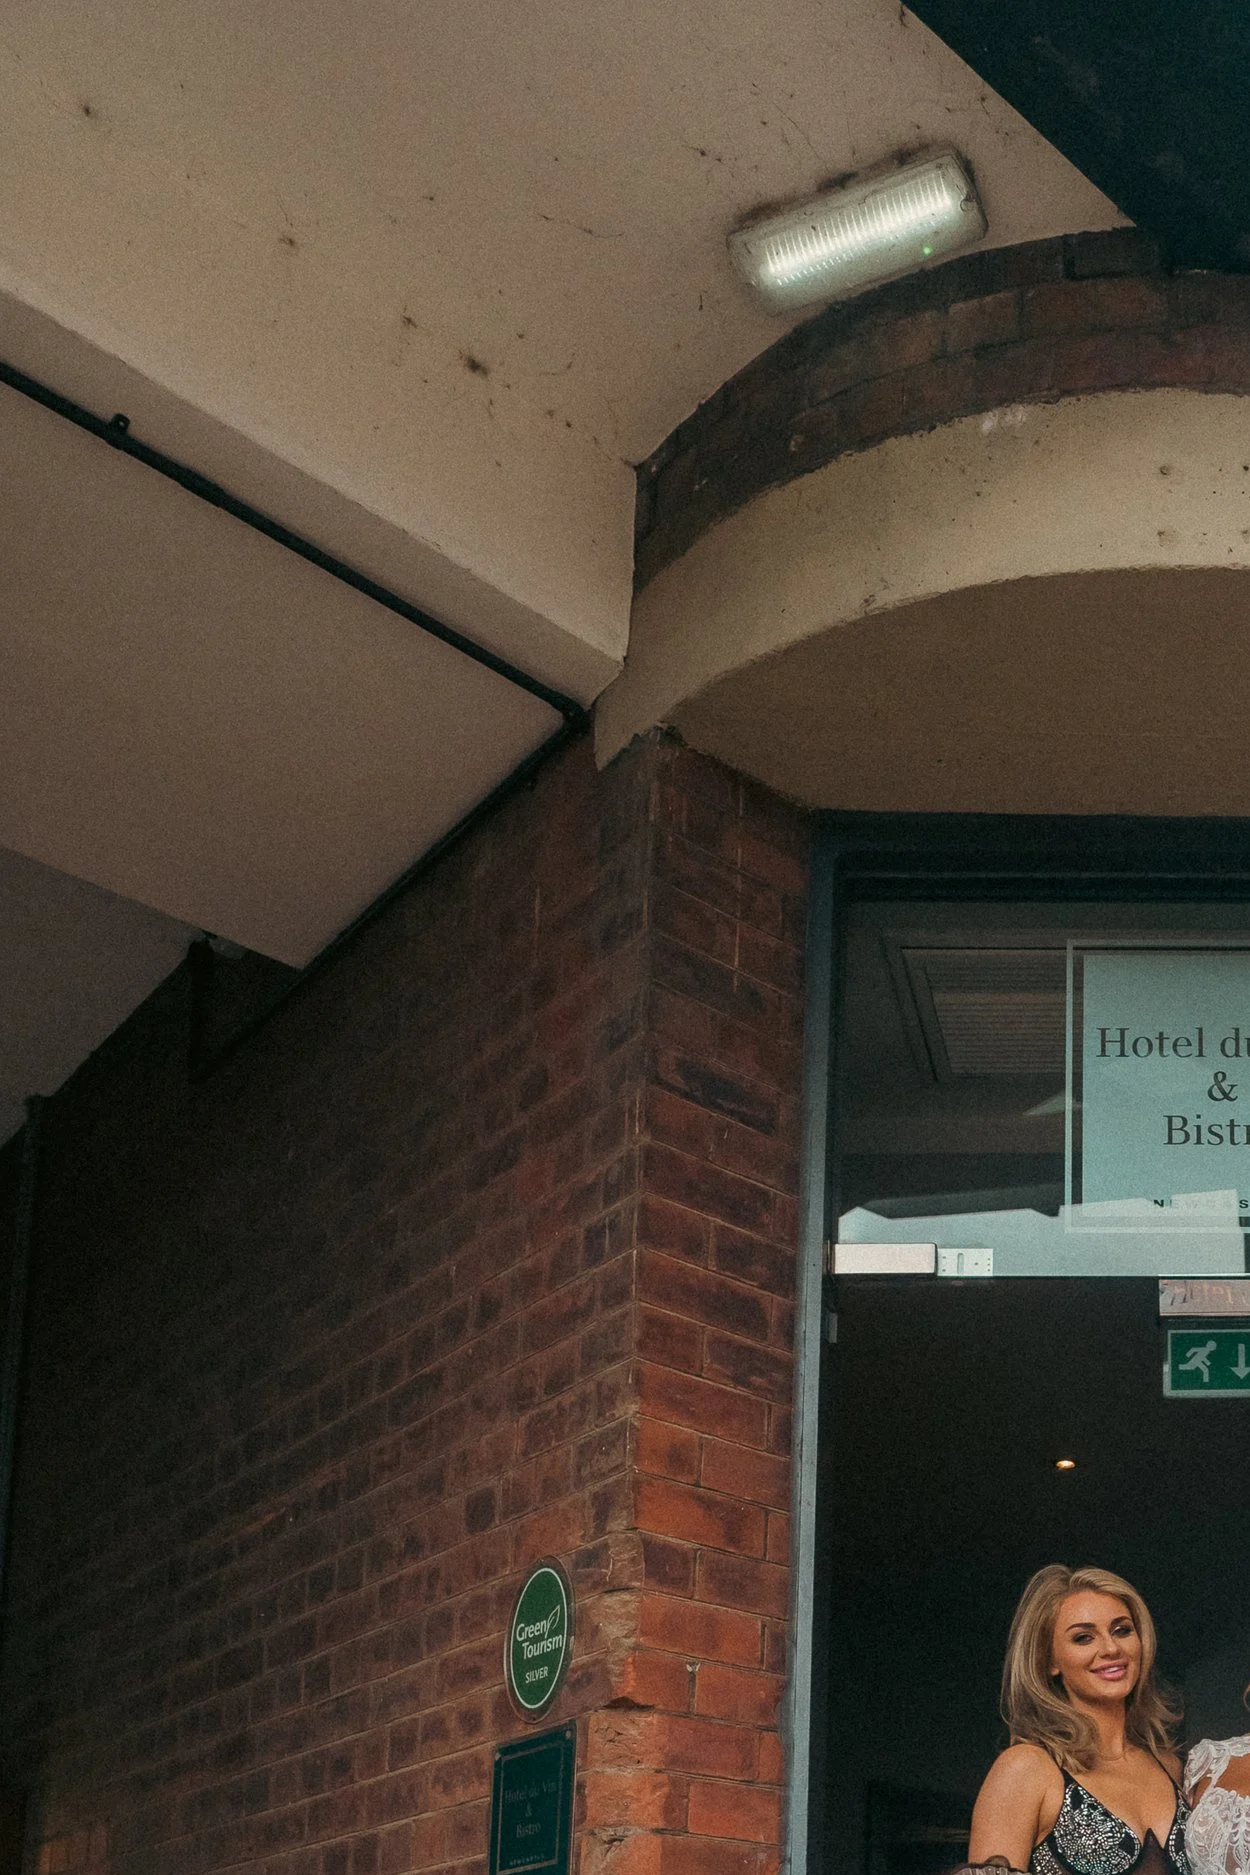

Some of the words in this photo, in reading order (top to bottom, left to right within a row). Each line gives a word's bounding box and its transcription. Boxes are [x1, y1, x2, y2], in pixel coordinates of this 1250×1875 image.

[1096, 1026, 1207, 1058] Hotel
[1206, 1070, 1239, 1102] &
[516, 1619, 548, 1642] Green
[521, 1634, 563, 1660] Tourism
[525, 1665, 549, 1684] SILVER
